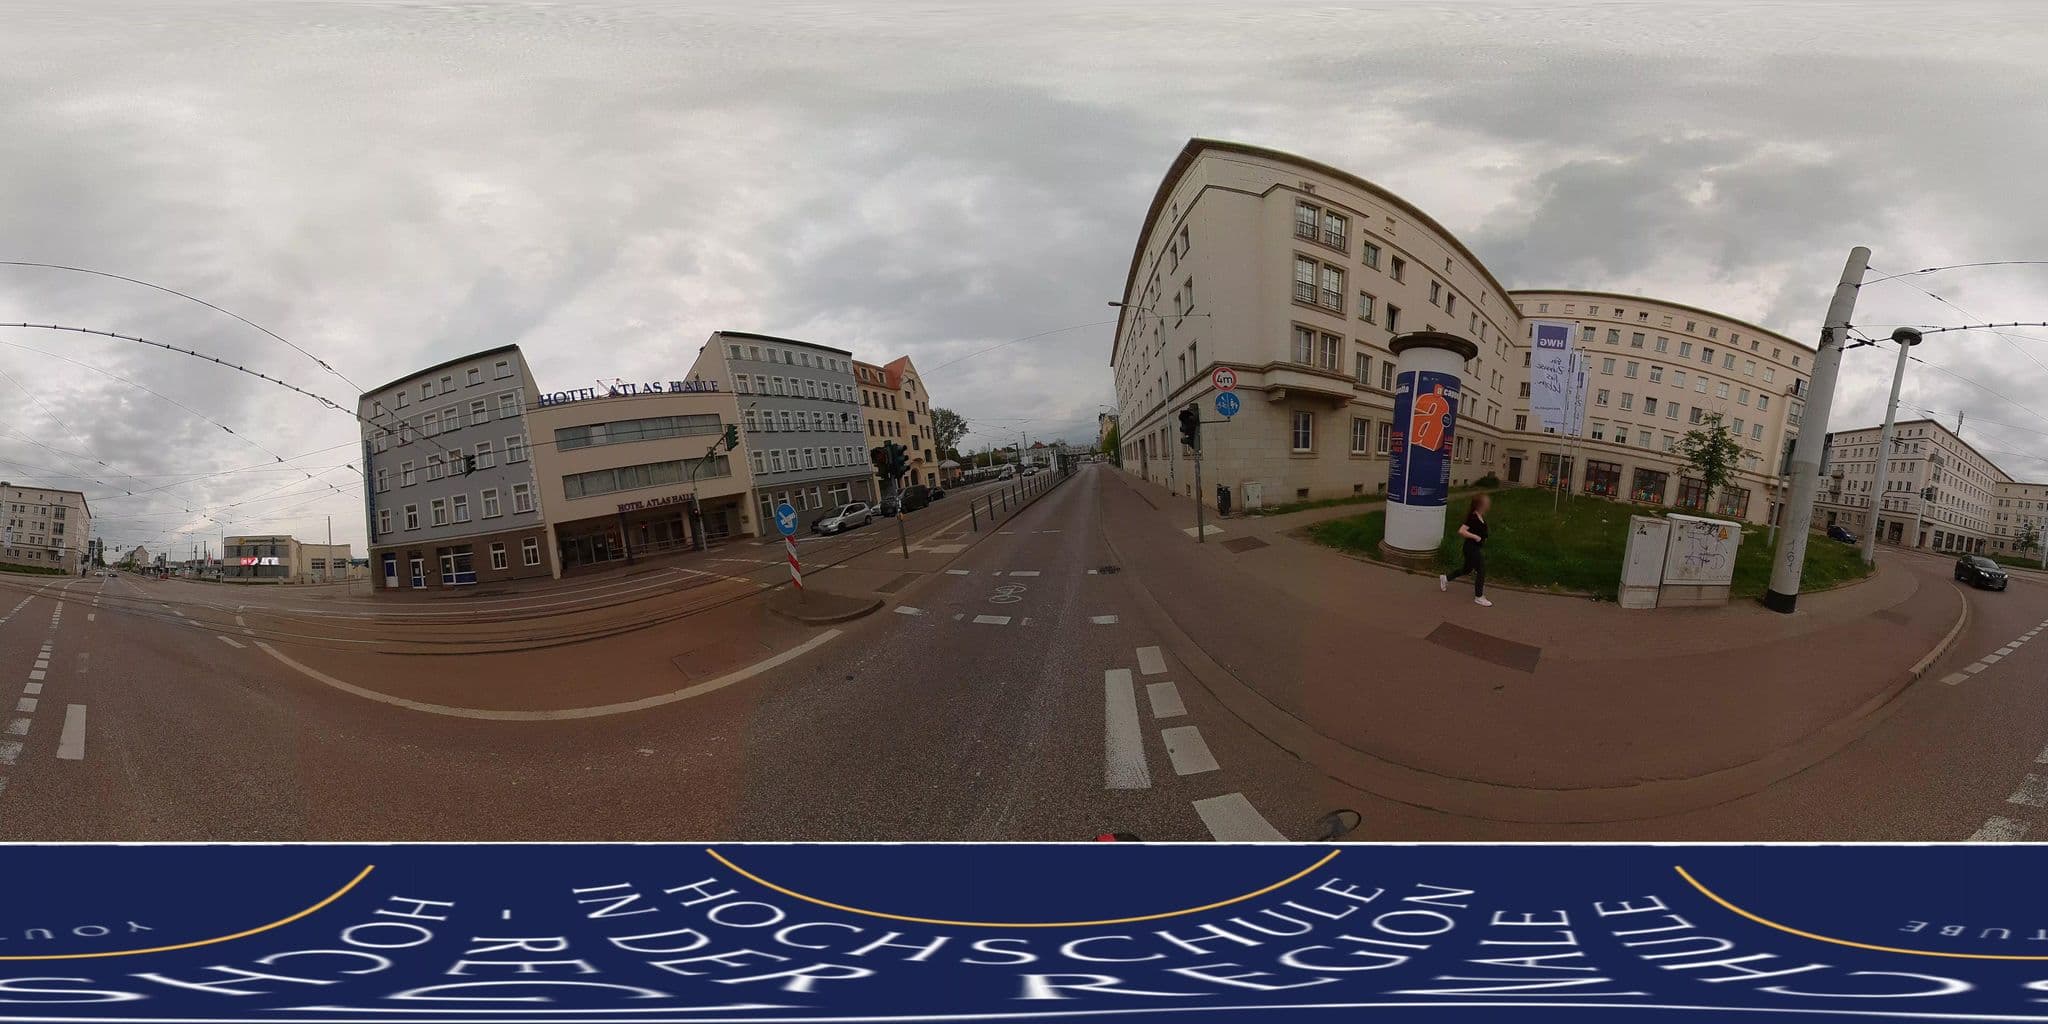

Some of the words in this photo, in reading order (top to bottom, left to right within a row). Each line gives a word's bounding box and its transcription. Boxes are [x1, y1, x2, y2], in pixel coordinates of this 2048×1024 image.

[1216, 375, 1232, 384] 4m
[538, 387, 596, 408] HOTEL
[609, 381, 663, 397] ATLAS
[669, 380, 720, 393] HALLE
[617, 501, 645, 512] HOTEL
[646, 496, 671, 508] ATLAS
[671, 493, 695, 504] HALLE
